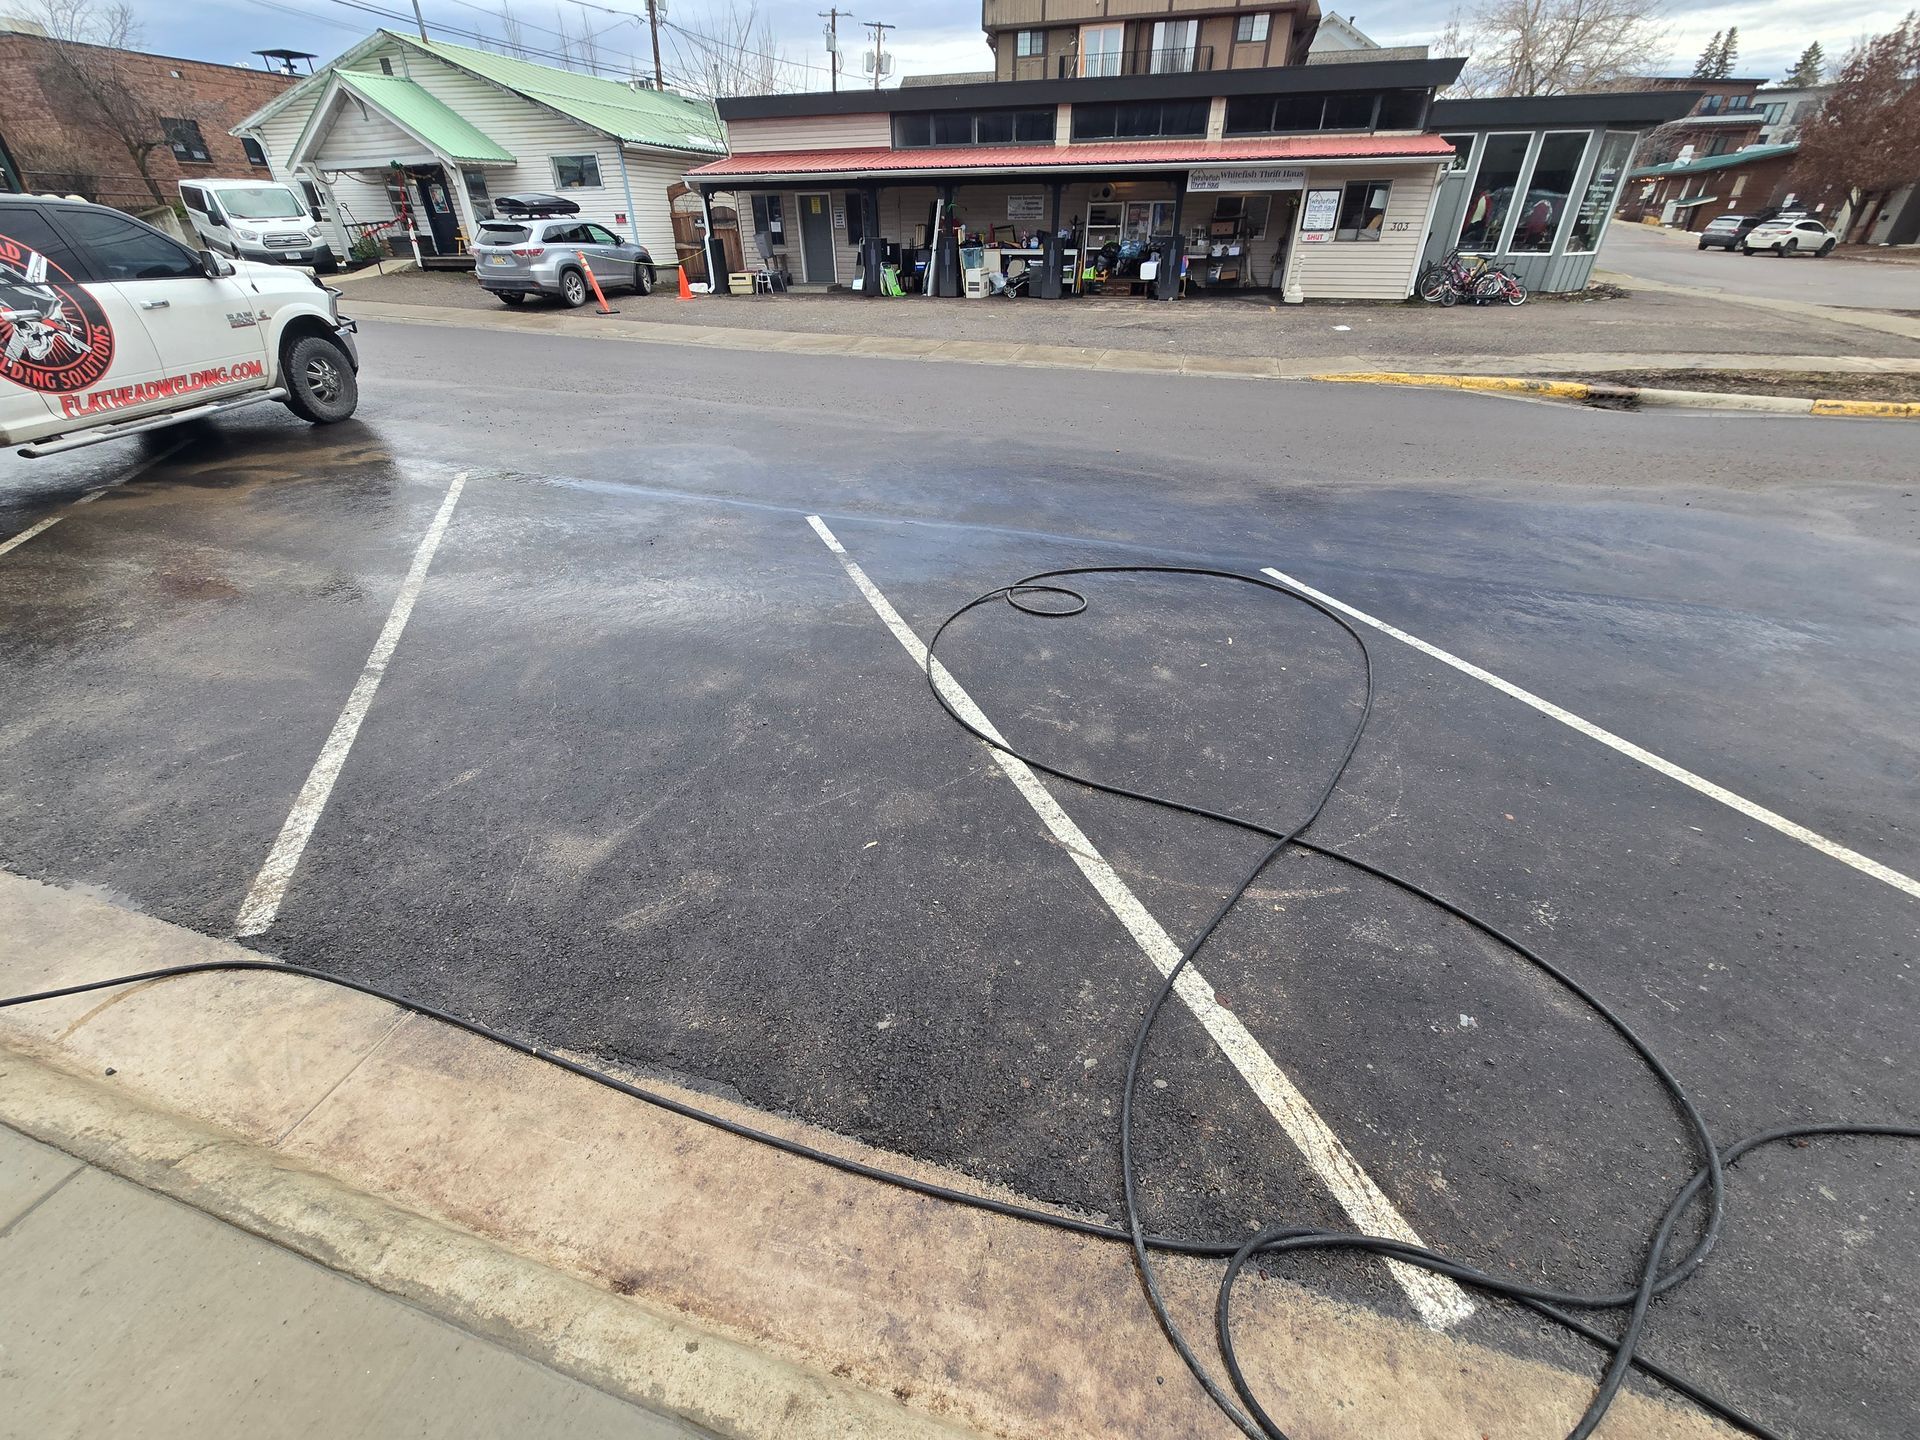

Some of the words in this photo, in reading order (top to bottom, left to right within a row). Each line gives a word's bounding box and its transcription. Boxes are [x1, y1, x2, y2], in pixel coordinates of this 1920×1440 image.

[1220, 170, 1257, 179] Whitefish
[1260, 170, 1281, 178] Thrift
[1283, 169, 1304, 177] Haus
[1390, 222, 1410, 231] 303
[59, 323, 111, 389] SOLUTIONS
[58, 360, 263, 420] FLATHEADWELDING.COM
